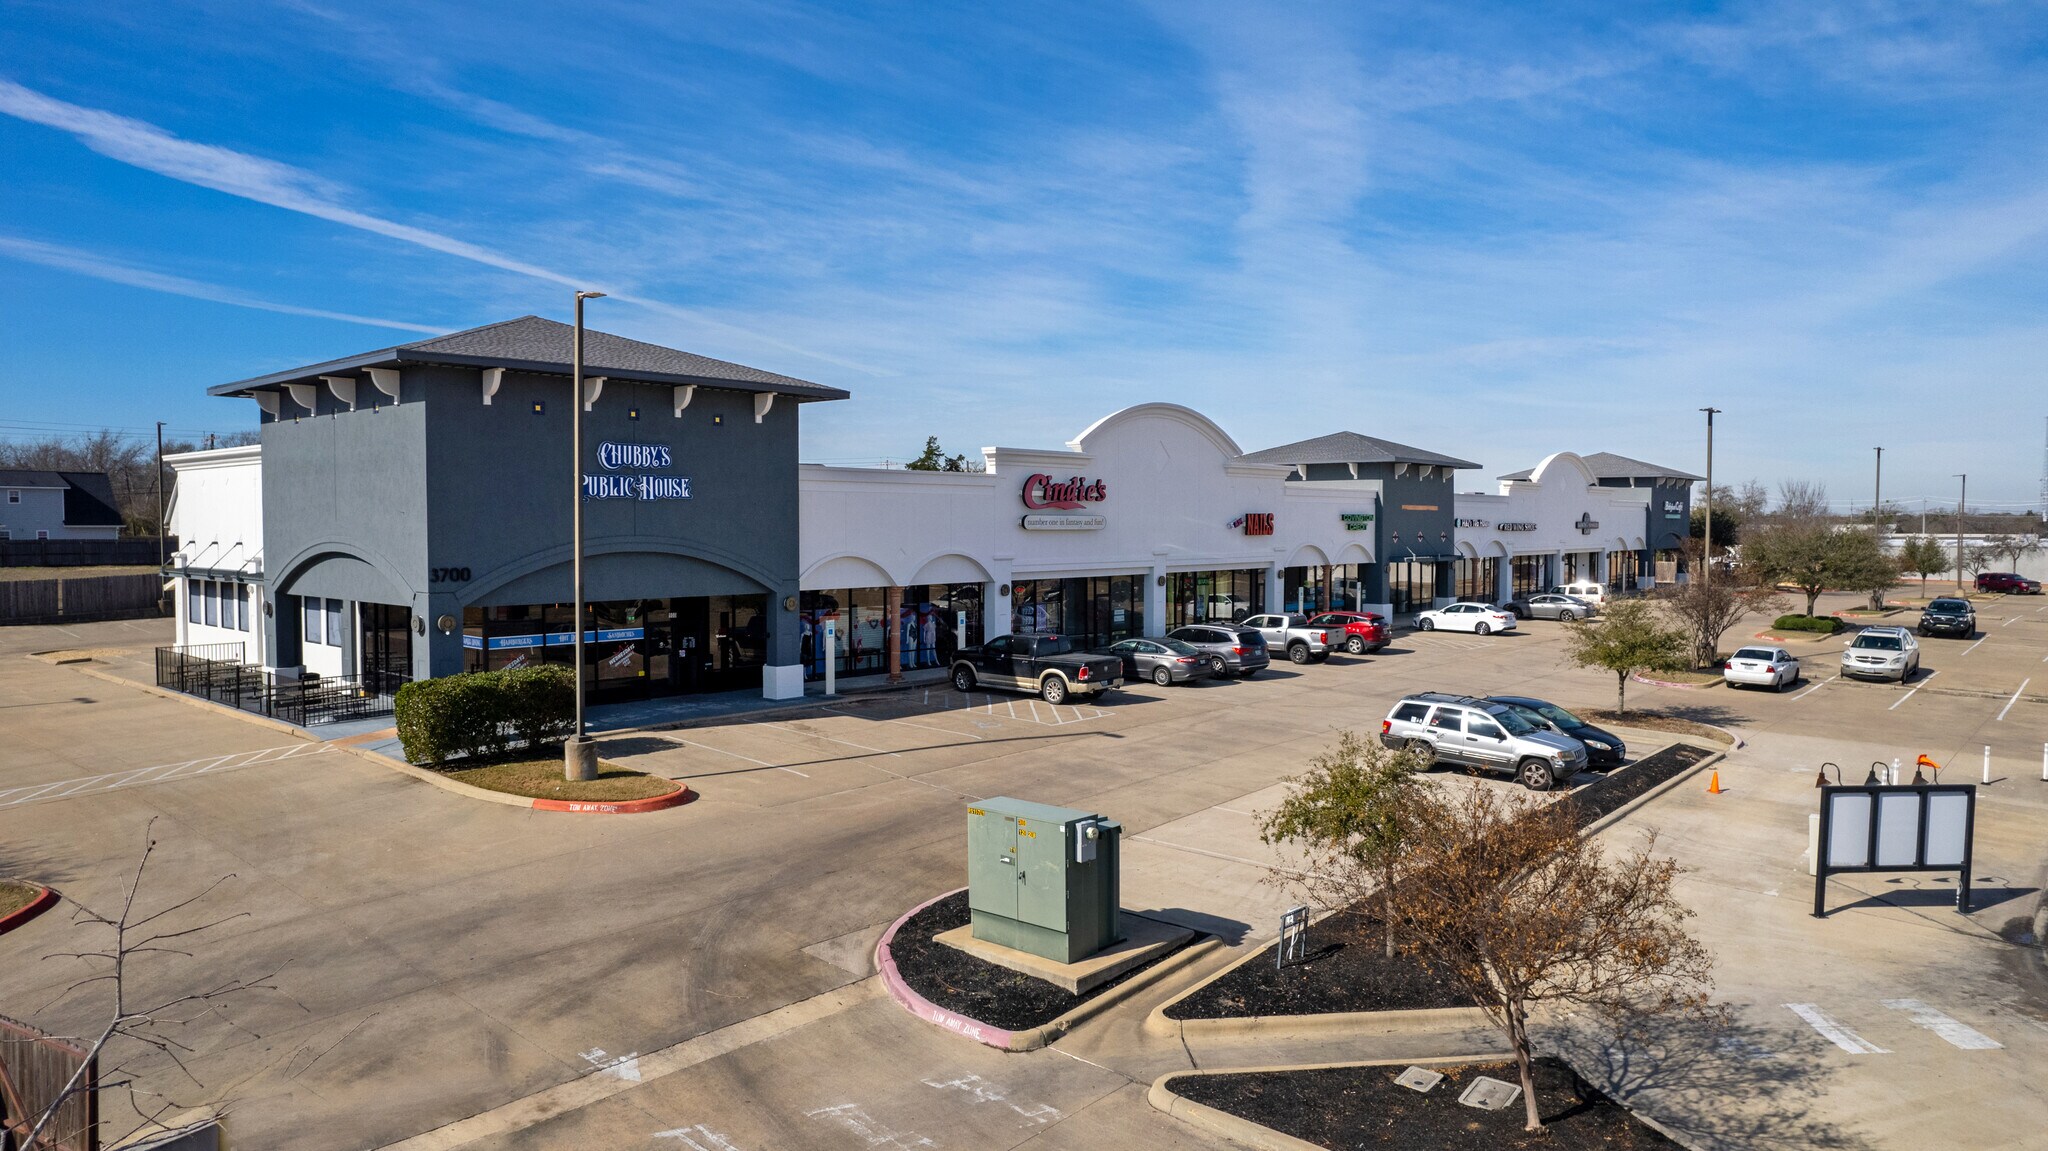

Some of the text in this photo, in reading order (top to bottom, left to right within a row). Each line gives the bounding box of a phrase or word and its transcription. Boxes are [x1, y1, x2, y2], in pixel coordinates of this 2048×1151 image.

[598, 442, 671, 469] CHUBBY'S
[635, 475, 690, 500] HOUSE
[1022, 474, 1107, 510] Cindie's
[1027, 517, 1048, 526] number
[1083, 517, 1094, 526] and
[1245, 513, 1274, 535] NAILS
[430, 566, 471, 583] 3700
[932, 1010, 981, 1040] TOW AWAY ZONE
